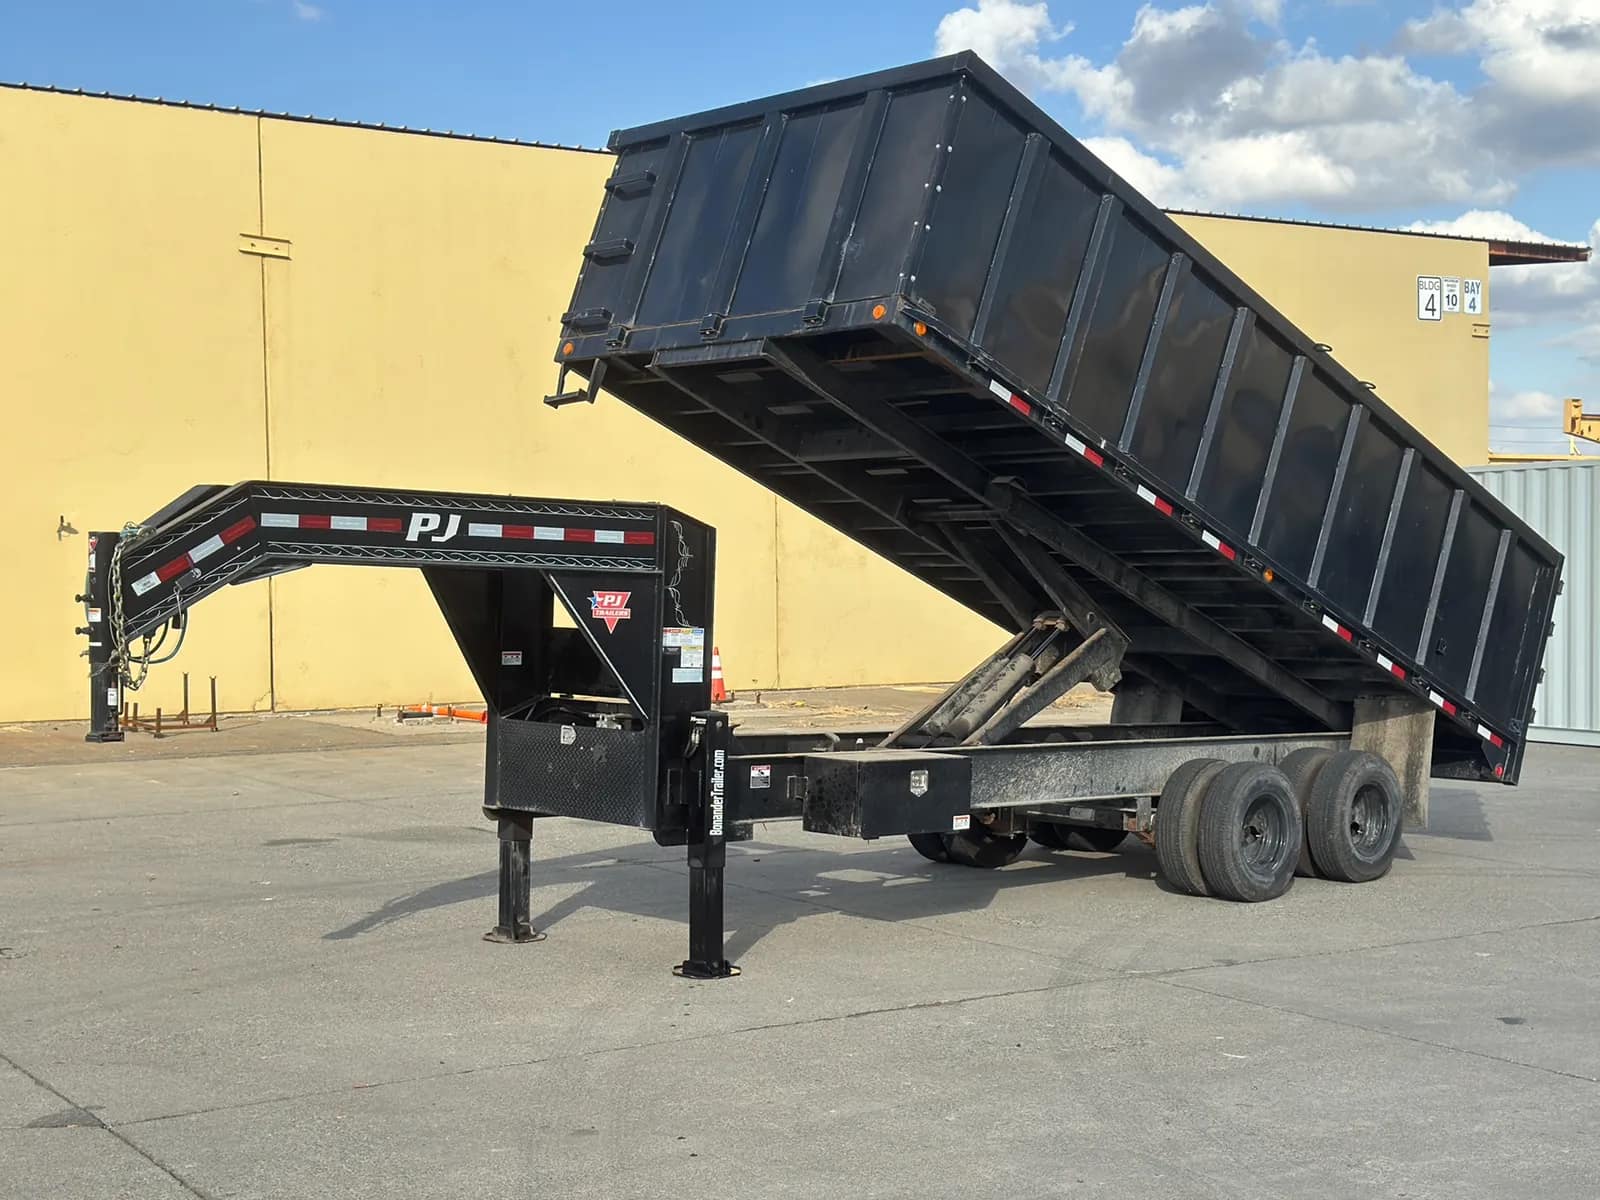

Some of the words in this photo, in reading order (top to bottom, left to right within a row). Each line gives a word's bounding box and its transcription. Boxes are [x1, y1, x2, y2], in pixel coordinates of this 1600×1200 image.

[1419, 280, 1440, 291] BLDG
[1464, 281, 1481, 294] BAY
[1425, 293, 1436, 316] 4
[1446, 294, 1457, 306] 10
[1469, 297, 1477, 312] 4
[405, 512, 462, 543] PJ
[602, 594, 623, 607] PJ
[709, 749, 725, 836] BonanderTrailer.com
